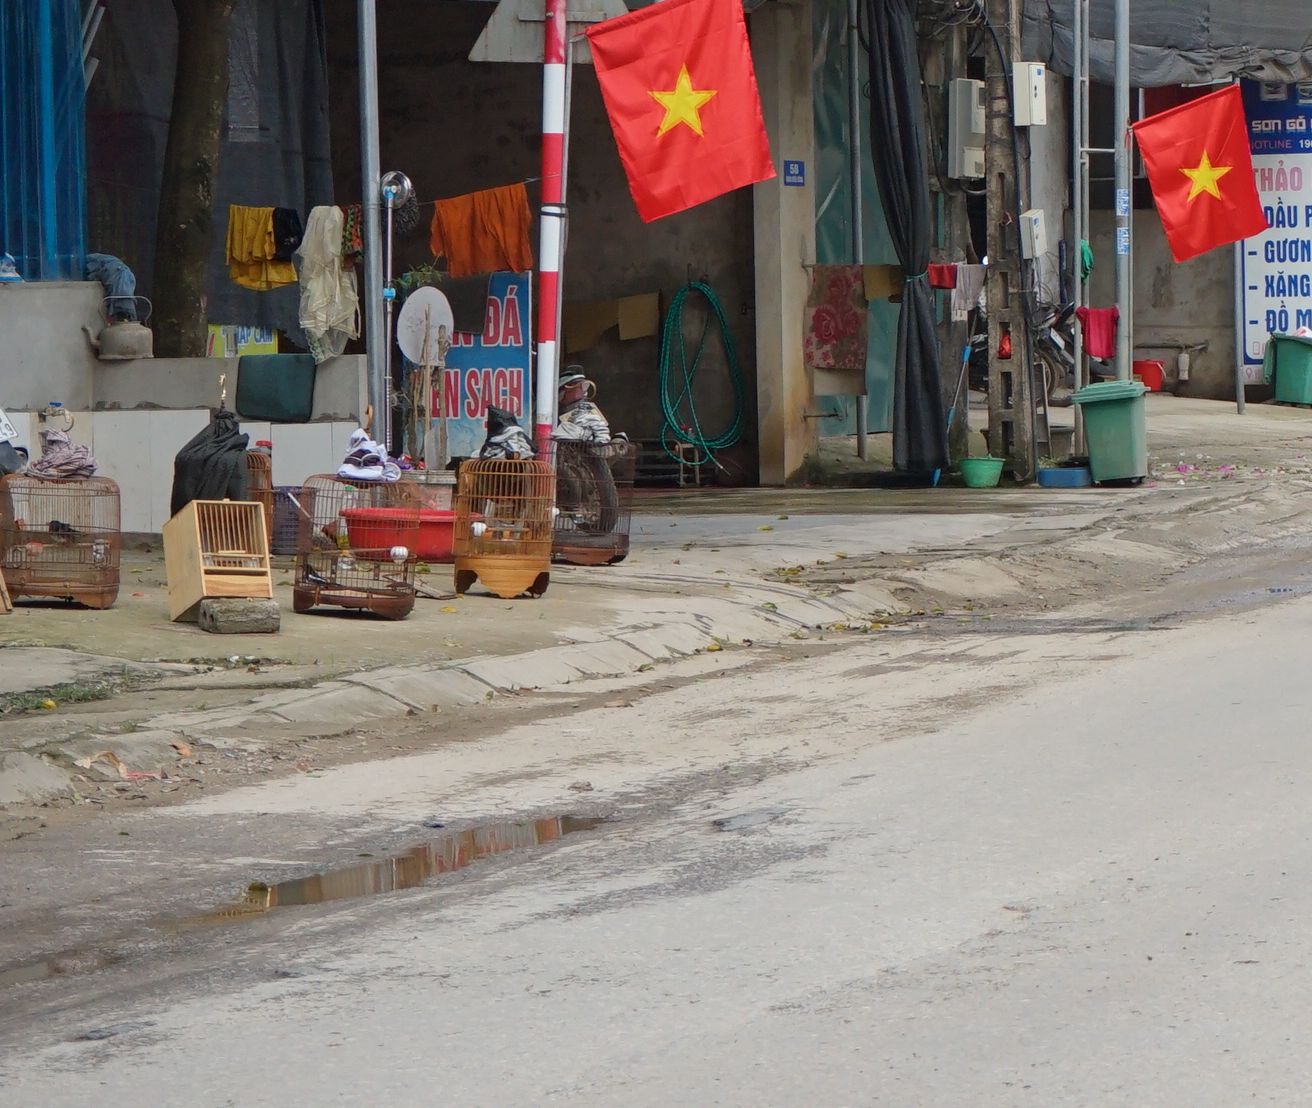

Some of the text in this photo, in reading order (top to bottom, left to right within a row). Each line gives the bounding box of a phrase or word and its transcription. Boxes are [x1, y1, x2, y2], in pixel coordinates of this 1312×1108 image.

[1264, 197, 1298, 228] DẦU
[1264, 271, 1311, 297] XĂNG
[1265, 300, 1289, 332] ĐỒ
